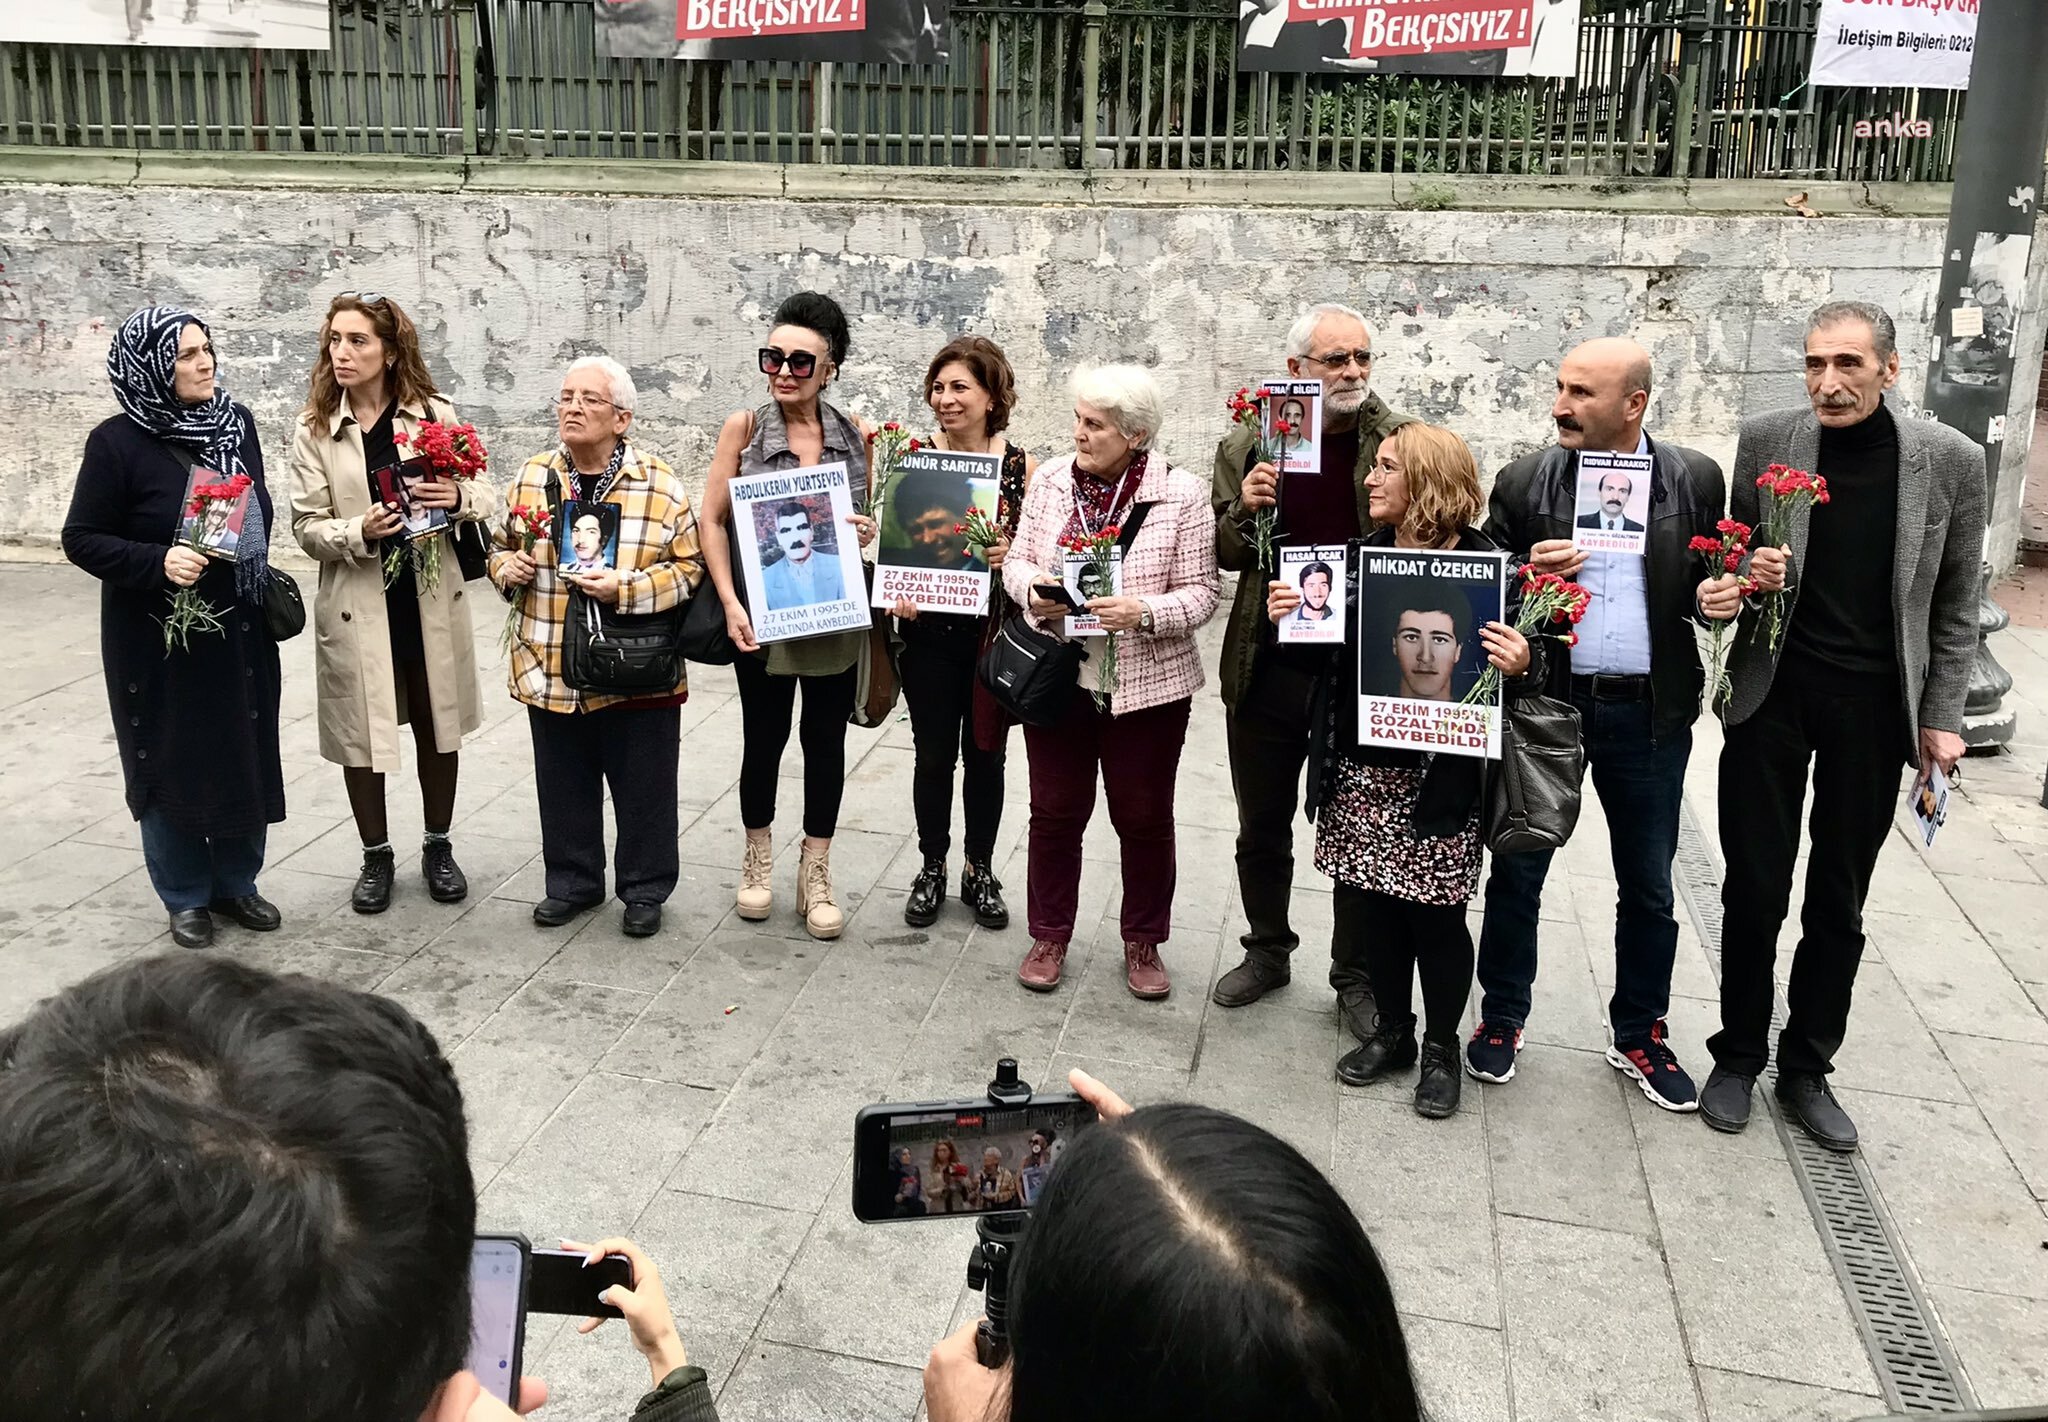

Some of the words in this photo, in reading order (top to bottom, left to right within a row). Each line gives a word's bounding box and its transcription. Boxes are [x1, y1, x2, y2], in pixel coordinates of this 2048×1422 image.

[1837, 24, 1892, 50] İletişim
[1896, 31, 1947, 52] Bilgileri:
[1949, 35, 1973, 52] 0212
[940, 459, 993, 478] SARITAŞ
[734, 477, 792, 502] ABDULKERİM
[794, 470, 846, 493] YURTSEVEN
[1285, 552, 1316, 562] HASAN
[1317, 551, 1342, 561] OCAK
[884, 570, 899, 580] 27
[902, 571, 933, 582] EKİM
[937, 574, 981, 586] 1995'te
[1369, 555, 1427, 577] MİKDAT
[1430, 558, 1495, 580] ÖZEKEN
[883, 579, 980, 597] GÖZALTINDA
[762, 614, 776, 625] 27
[780, 607, 808, 621] EKİM
[812, 601, 858, 616] 1995'DE
[757, 622, 816, 640] GÖZALTINDA
[817, 612, 867, 630] KAYBEDİLDİ
[1370, 701, 1388, 713] 27
[1392, 702, 1430, 717] EKİM
